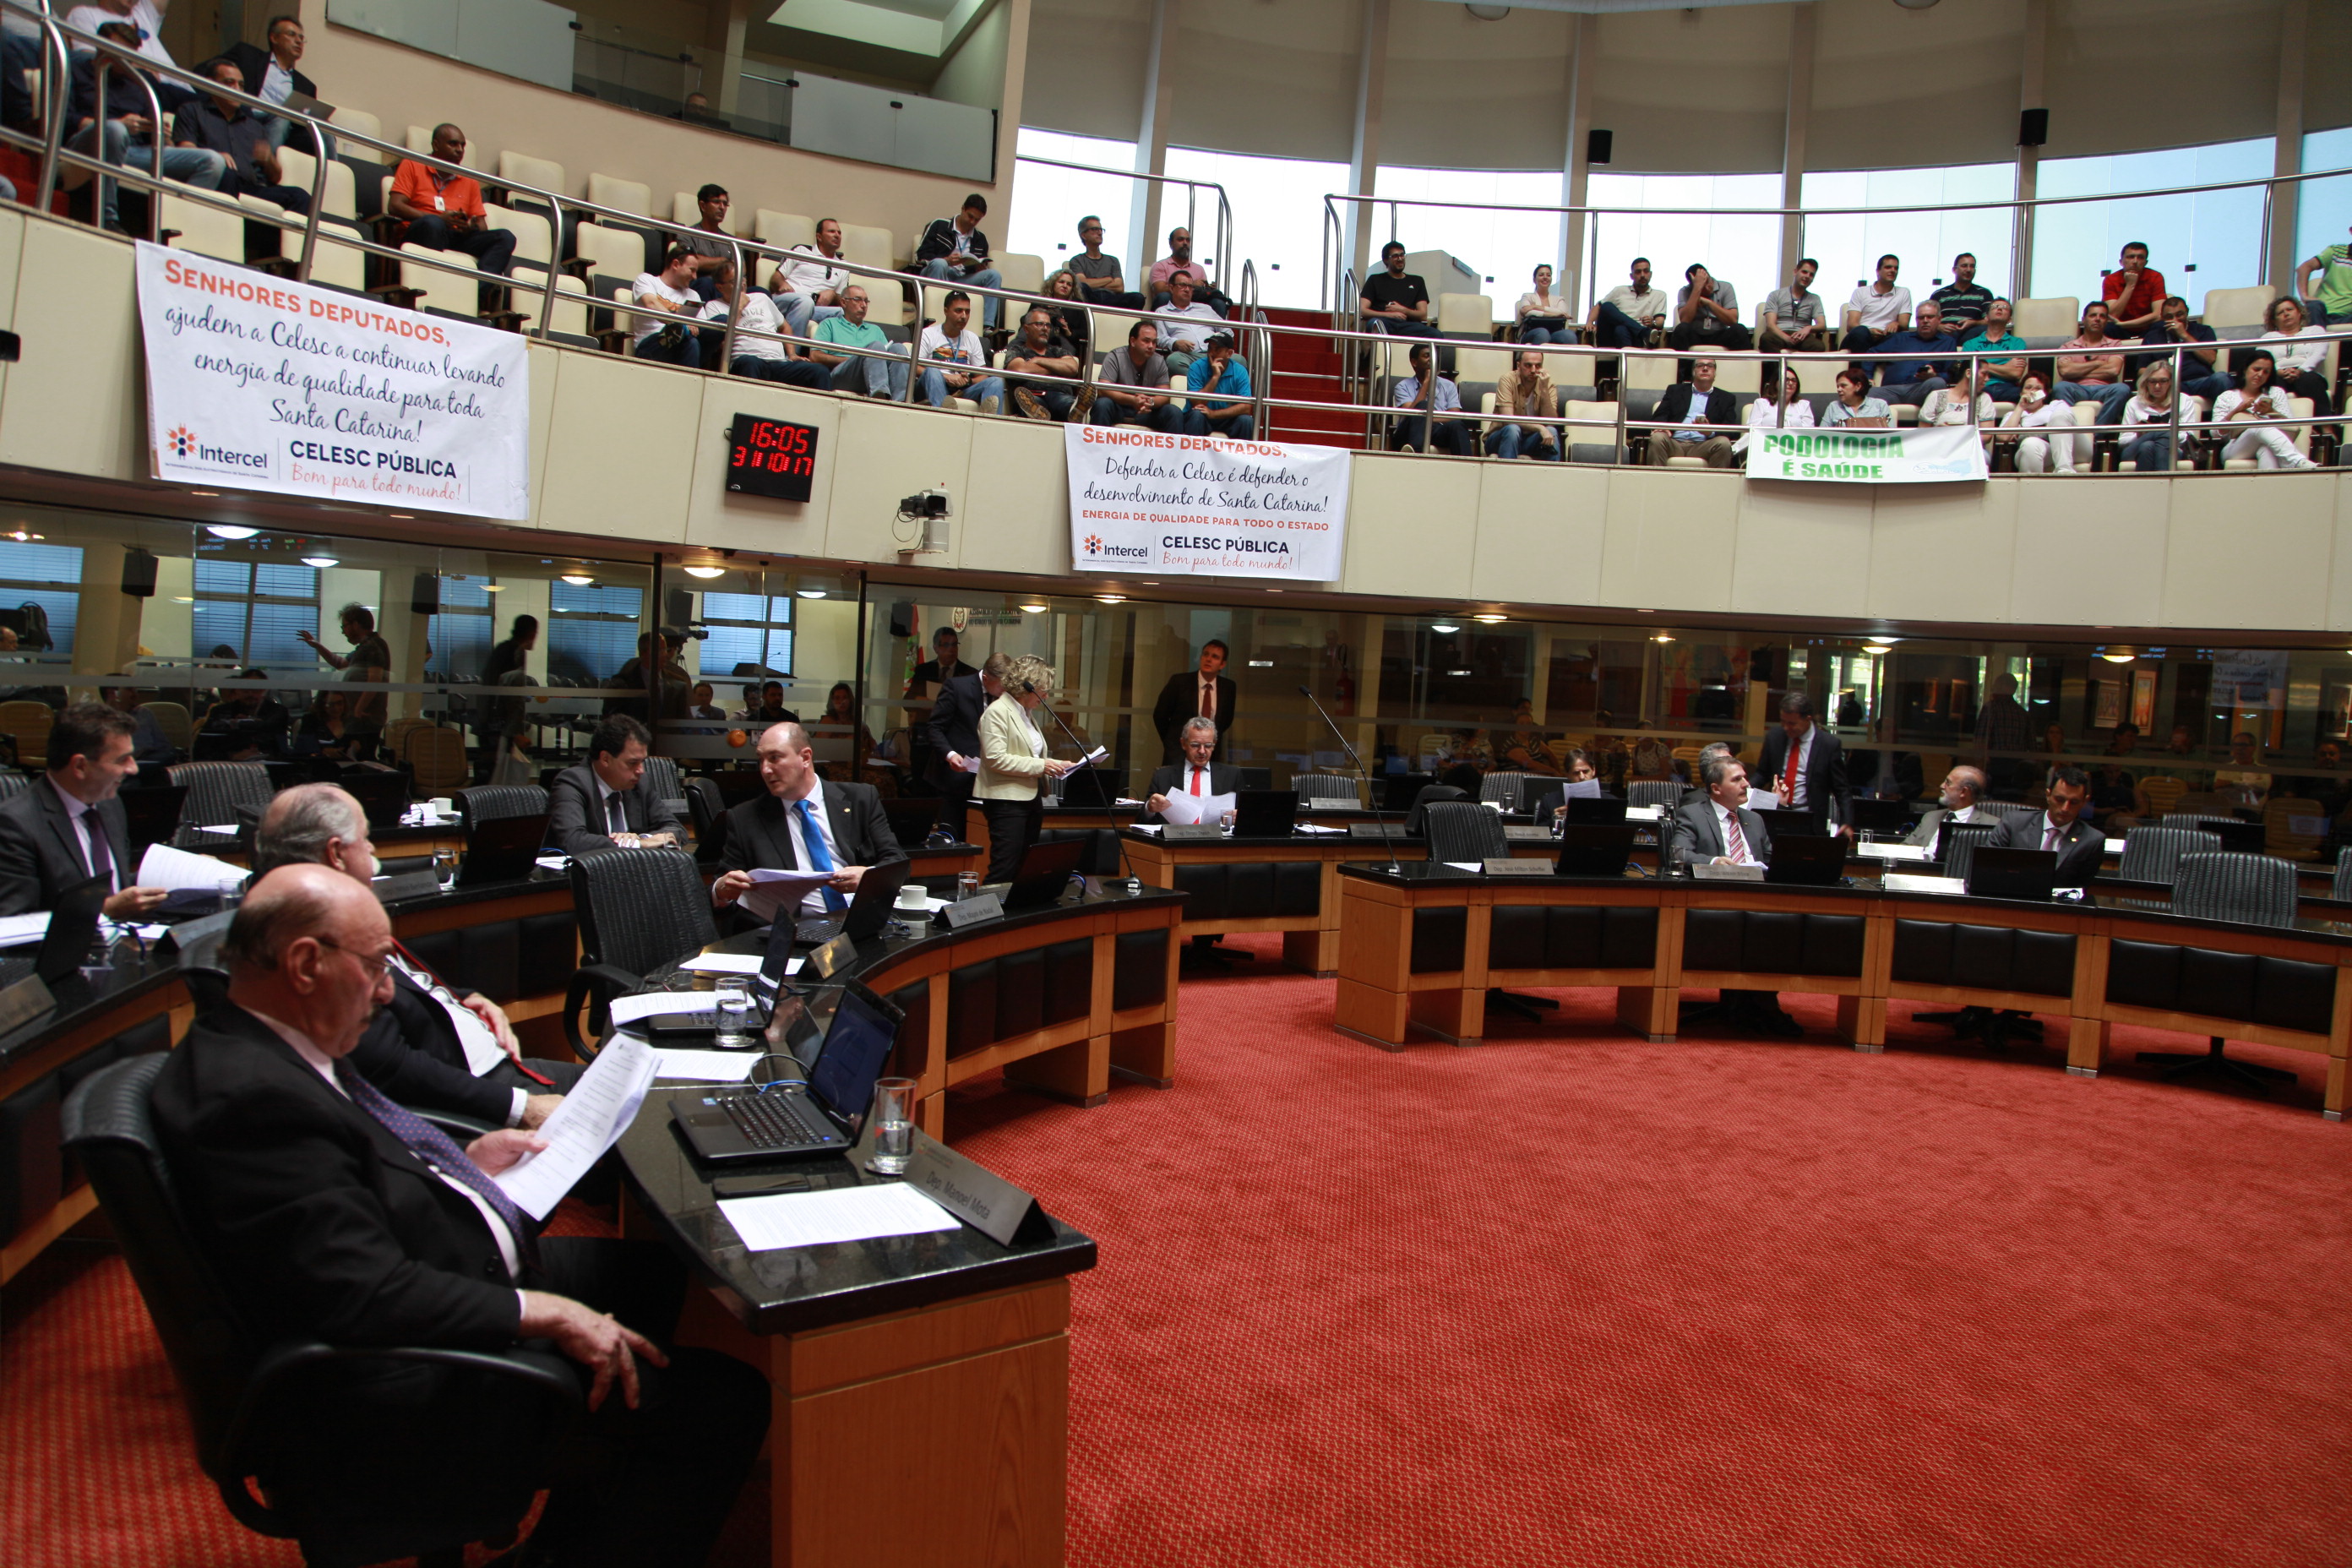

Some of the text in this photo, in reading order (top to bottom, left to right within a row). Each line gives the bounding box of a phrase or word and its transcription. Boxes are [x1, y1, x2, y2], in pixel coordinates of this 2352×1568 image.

[309, 299, 451, 347] DEPUTADOS,
[166, 304, 505, 389] ajudem a Celesc a continuar levando
[194, 352, 485, 421] energia de qualidade para toda
[269, 399, 422, 444] Santa Catarina!
[749, 422, 810, 455] 16:05
[1180, 437, 1288, 459] DEPUTADOS,
[1763, 434, 1904, 459] PODOLOGIA
[199, 444, 267, 469] Intercel
[290, 440, 457, 480] CELESC PÚBLICA
[1105, 456, 1309, 487] Defender a Celesc é defender o
[1782, 459, 1883, 479] É SAÚDE
[291, 462, 328, 487] Bom
[332, 473, 369, 496] para
[372, 474, 402, 495] todo
[406, 482, 461, 502] mundo!
[1083, 482, 1328, 514] desenvolvimento de Santa Catarina!
[1082, 509, 1329, 531] ENERGIA DE QUALIDADE PARA TODO O ESTADO
[1104, 544, 1148, 558] Intercel
[1162, 536, 1289, 554] CELESC PÚBLICA
[1162, 551, 1293, 573] Bom para todo mundo!
[926, 1171, 991, 1220] Dep. Manoel Mota
